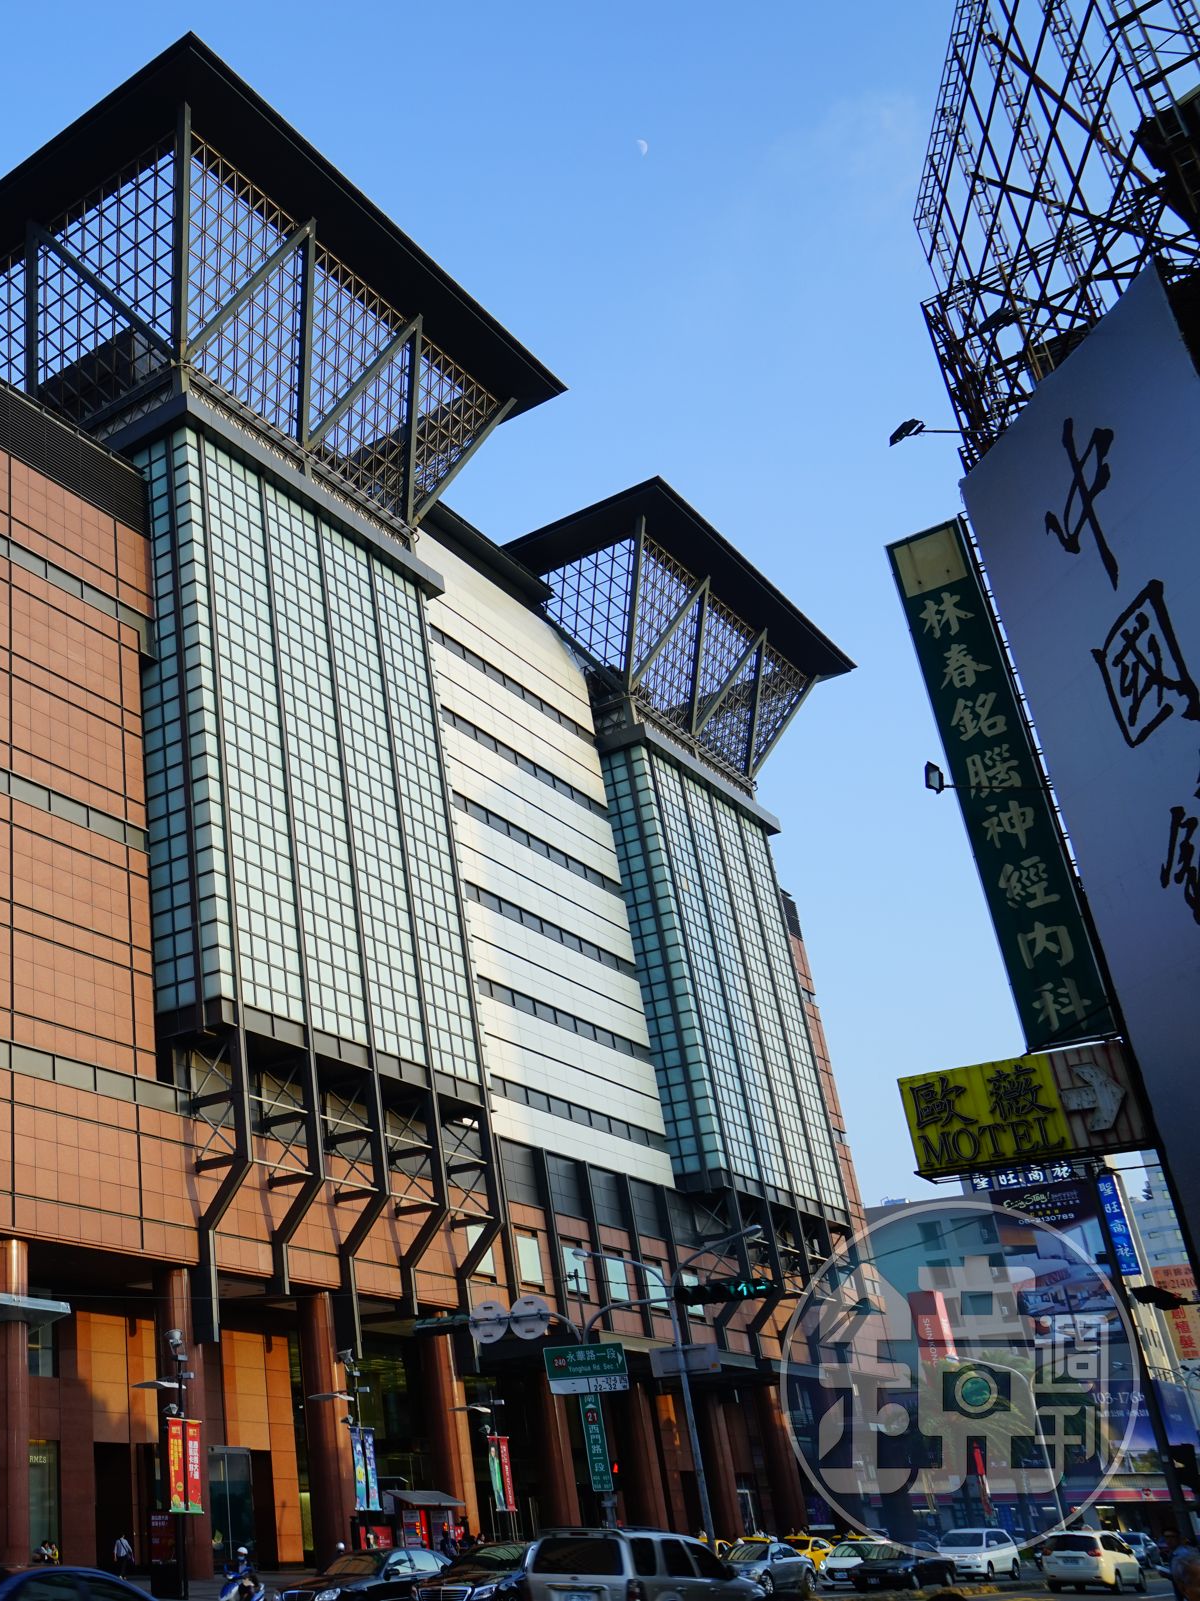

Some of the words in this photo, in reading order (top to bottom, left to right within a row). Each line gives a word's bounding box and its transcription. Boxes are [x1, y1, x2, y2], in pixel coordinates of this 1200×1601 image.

[918, 592, 1092, 1032] 林春銘腦神經內科
[909, 1064, 1057, 1130] 歐薇
[917, 1116, 1066, 1167] MOTEL
[1098, 1182, 1135, 1257] 聖旺商旅
[566, 1347, 617, 1363] 永華路一段
[587, 1411, 598, 1421] 21
[588, 1424, 605, 1472] 西門路一段
